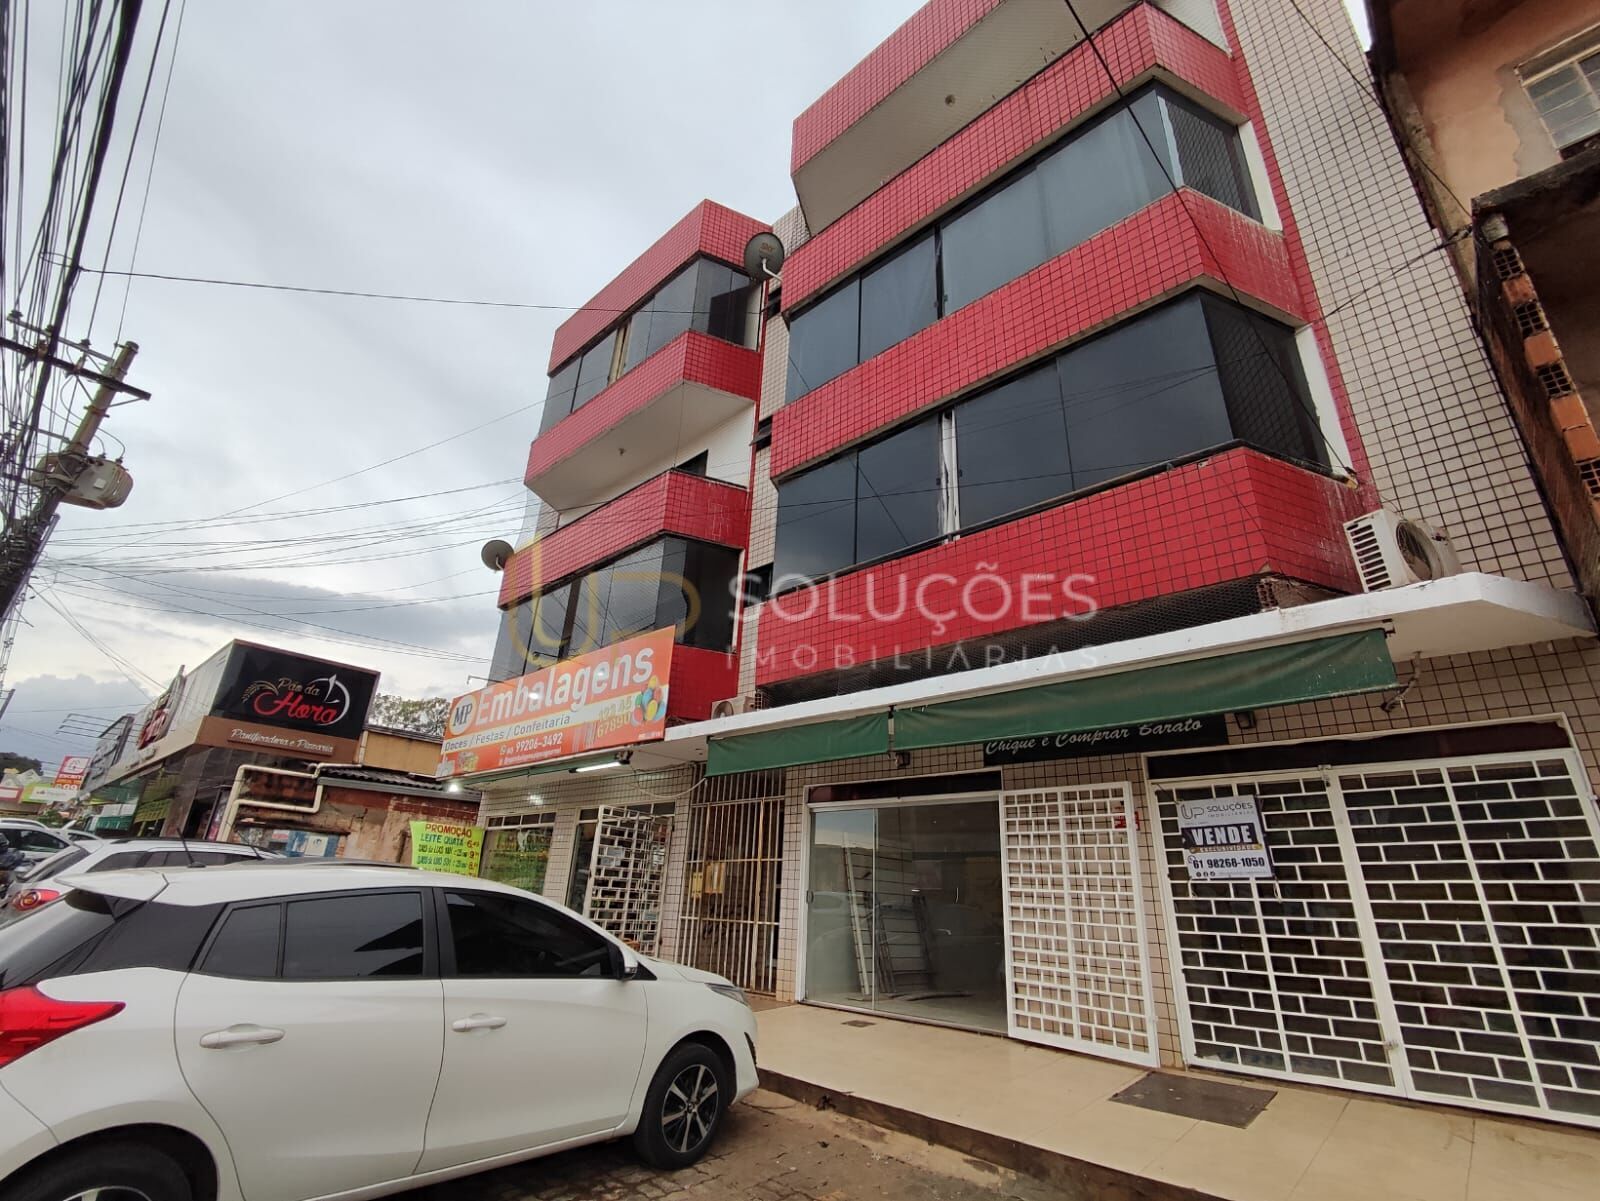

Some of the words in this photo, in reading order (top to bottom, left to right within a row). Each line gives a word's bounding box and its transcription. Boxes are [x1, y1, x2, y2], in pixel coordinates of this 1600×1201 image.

[304, 683, 320, 696] da
[475, 647, 655, 726] Embalagens
[253, 691, 338, 724] Hora
[452, 701, 473, 728] MP
[445, 738, 468, 753] Doces
[475, 730, 504, 746] Festas
[513, 714, 571, 736] Confeitaria
[985, 737, 1036, 755] Chique
[1042, 738, 1049, 747] e
[1055, 728, 1129, 747] Comprar
[1139, 718, 1203, 736] Barato
[1181, 803, 1204, 820] UP
[1206, 802, 1253, 813] SOLUÇÕES
[420, 833, 442, 843] LEITE
[425, 823, 472, 838] PROMOÇÃO
[1191, 825, 1253, 846] VENDE
[1192, 859, 1204, 869] 61
[1206, 857, 1265, 869] 98268-1050
